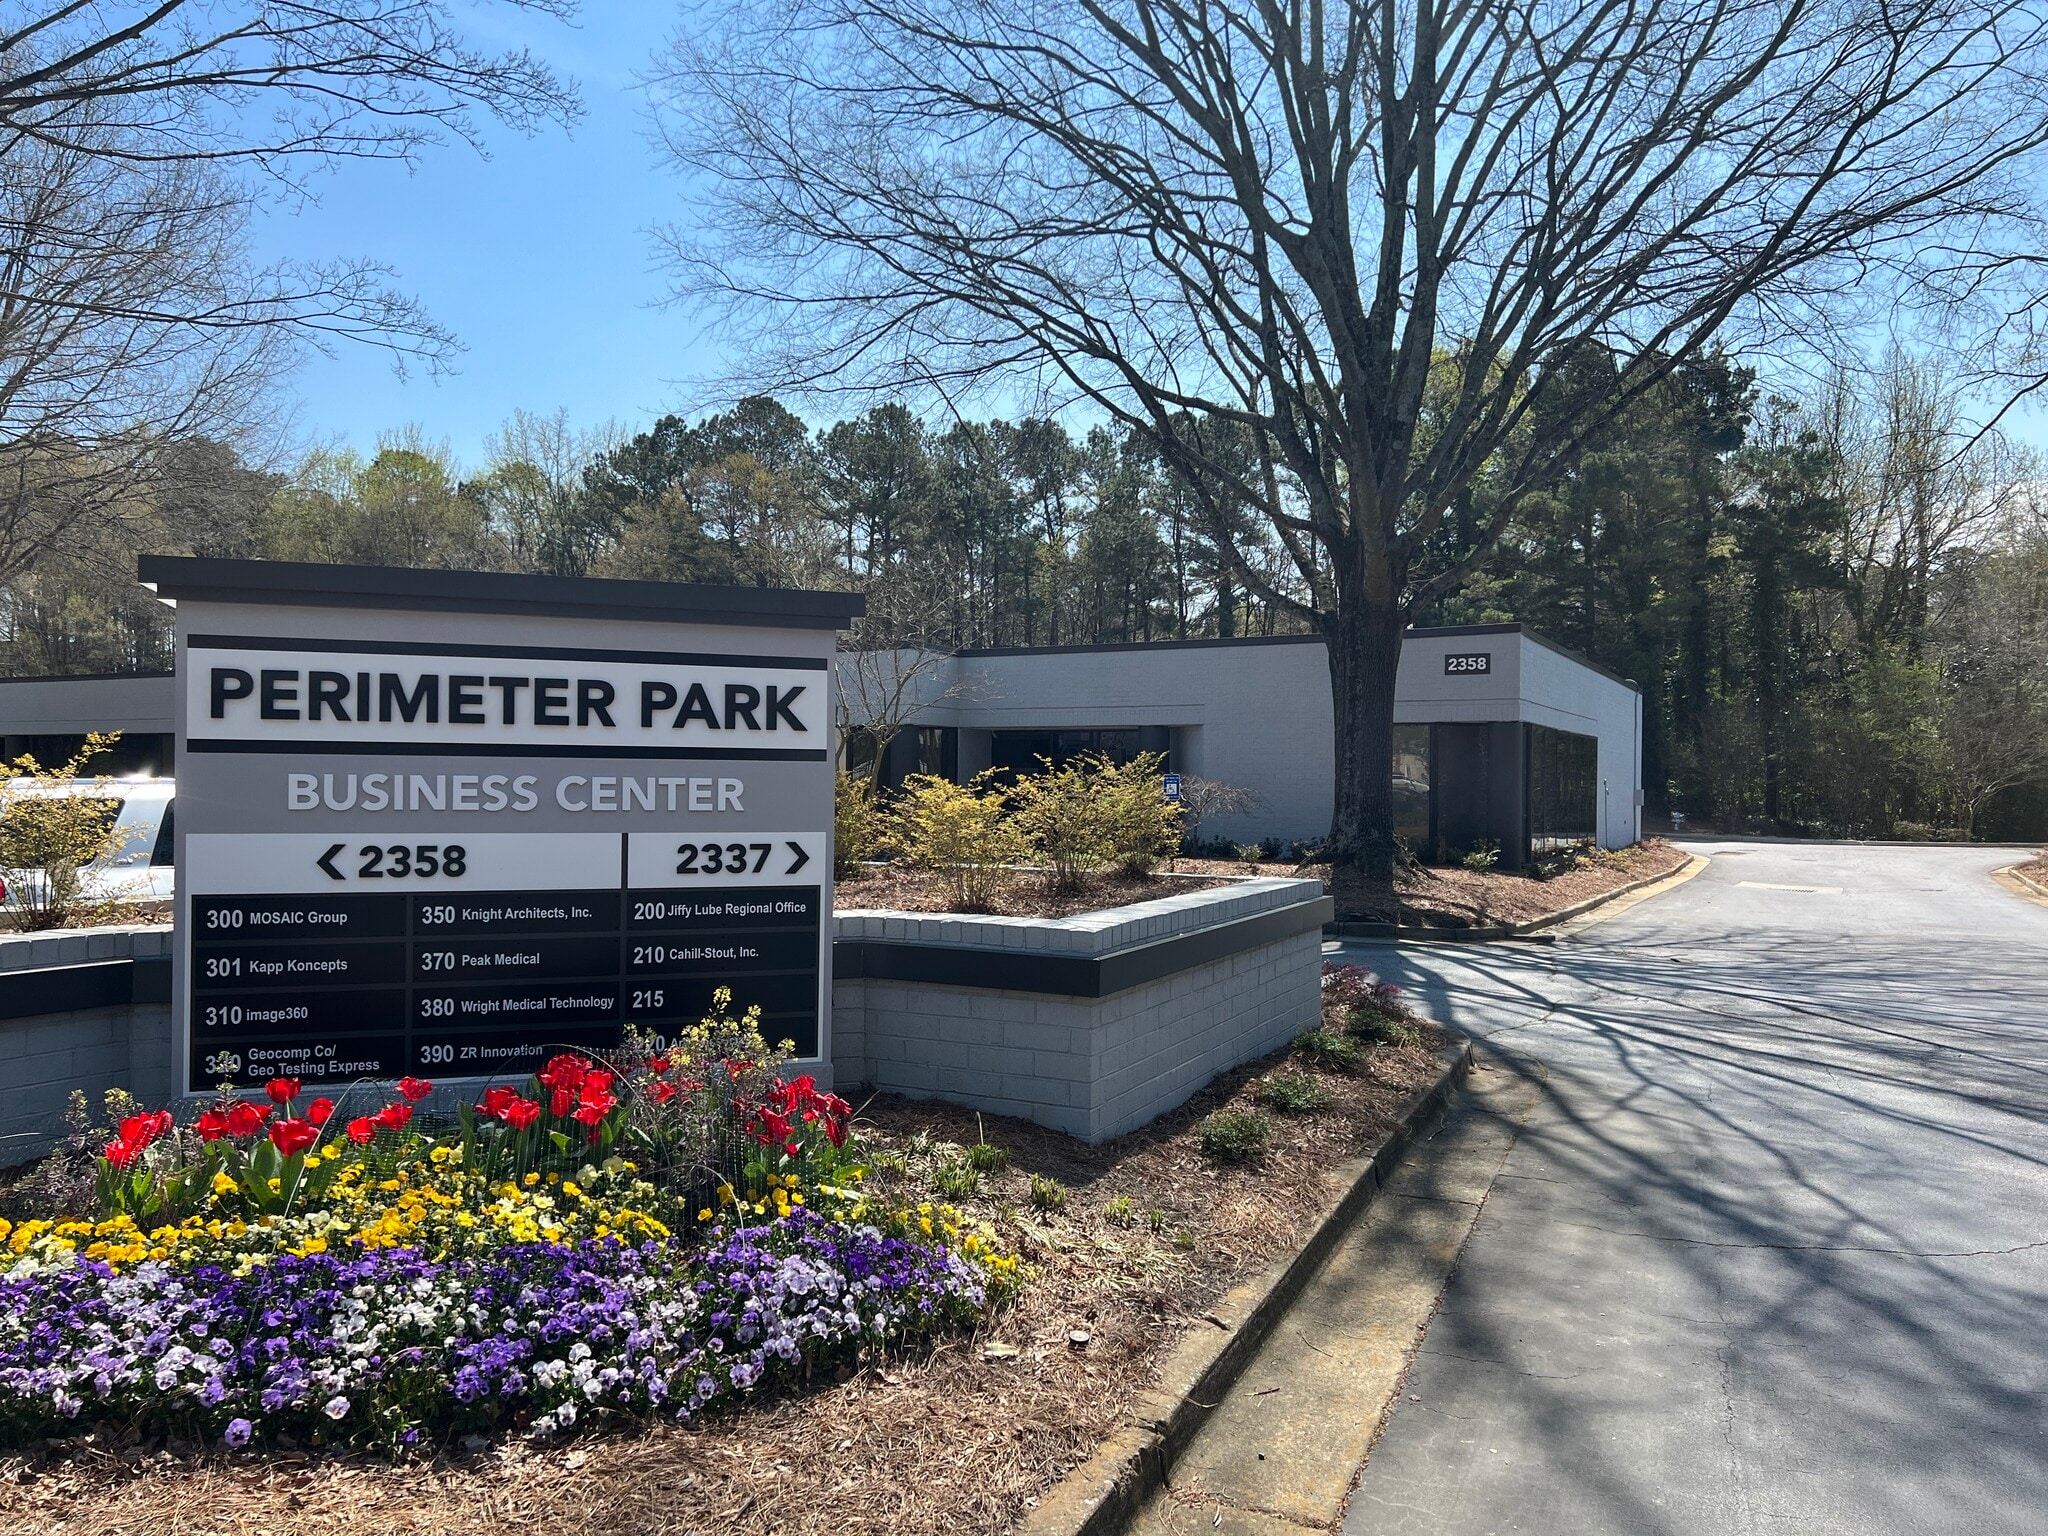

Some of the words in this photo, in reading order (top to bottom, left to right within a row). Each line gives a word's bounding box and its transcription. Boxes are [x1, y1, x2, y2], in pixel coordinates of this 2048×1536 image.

[1448, 658, 1486, 671] 2358
[210, 668, 615, 728] PERIMETER
[641, 681, 808, 732] PARK
[287, 773, 538, 812] BUSINESS
[555, 775, 744, 812] CENTER
[359, 845, 466, 879] 2358
[676, 843, 771, 874] 2337
[207, 910, 243, 928] 300
[250, 912, 304, 924] MOSAIC
[308, 912, 348, 925] Group
[422, 906, 455, 923] 350
[462, 908, 502, 923] Knight
[505, 907, 568, 919] Architects,
[571, 907, 592, 918] Inc.
[634, 903, 665, 920] 200
[668, 903, 692, 917] Jiffy
[695, 903, 721, 914] Lube
[725, 902, 772, 916] Regional
[775, 901, 806, 913] Office
[422, 952, 455, 970] 370
[462, 953, 490, 966] Peak
[495, 953, 540, 964] Medical
[633, 946, 664, 963] 210
[670, 947, 736, 960] Cahill-Stout,
[739, 947, 759, 958] Inc.
[206, 958, 241, 976] 301
[249, 961, 283, 974] Kapp
[287, 959, 348, 972] Koncepts
[421, 999, 454, 1016] 380
[461, 999, 499, 1014] Wright
[503, 997, 546, 1009] Medical
[550, 995, 614, 1009] Technology
[633, 990, 663, 1007] 215
[205, 1006, 242, 1025] 310
[246, 1007, 308, 1023] image360
[249, 1047, 311, 1060] Geocomp
[314, 1045, 336, 1056] Co/
[421, 1045, 453, 1062] 390
[460, 1047, 477, 1058] ZR
[480, 1044, 543, 1056] Innovation
[248, 1064, 274, 1076] Geo
[278, 1062, 325, 1076] Testing
[329, 1060, 379, 1073] Express
